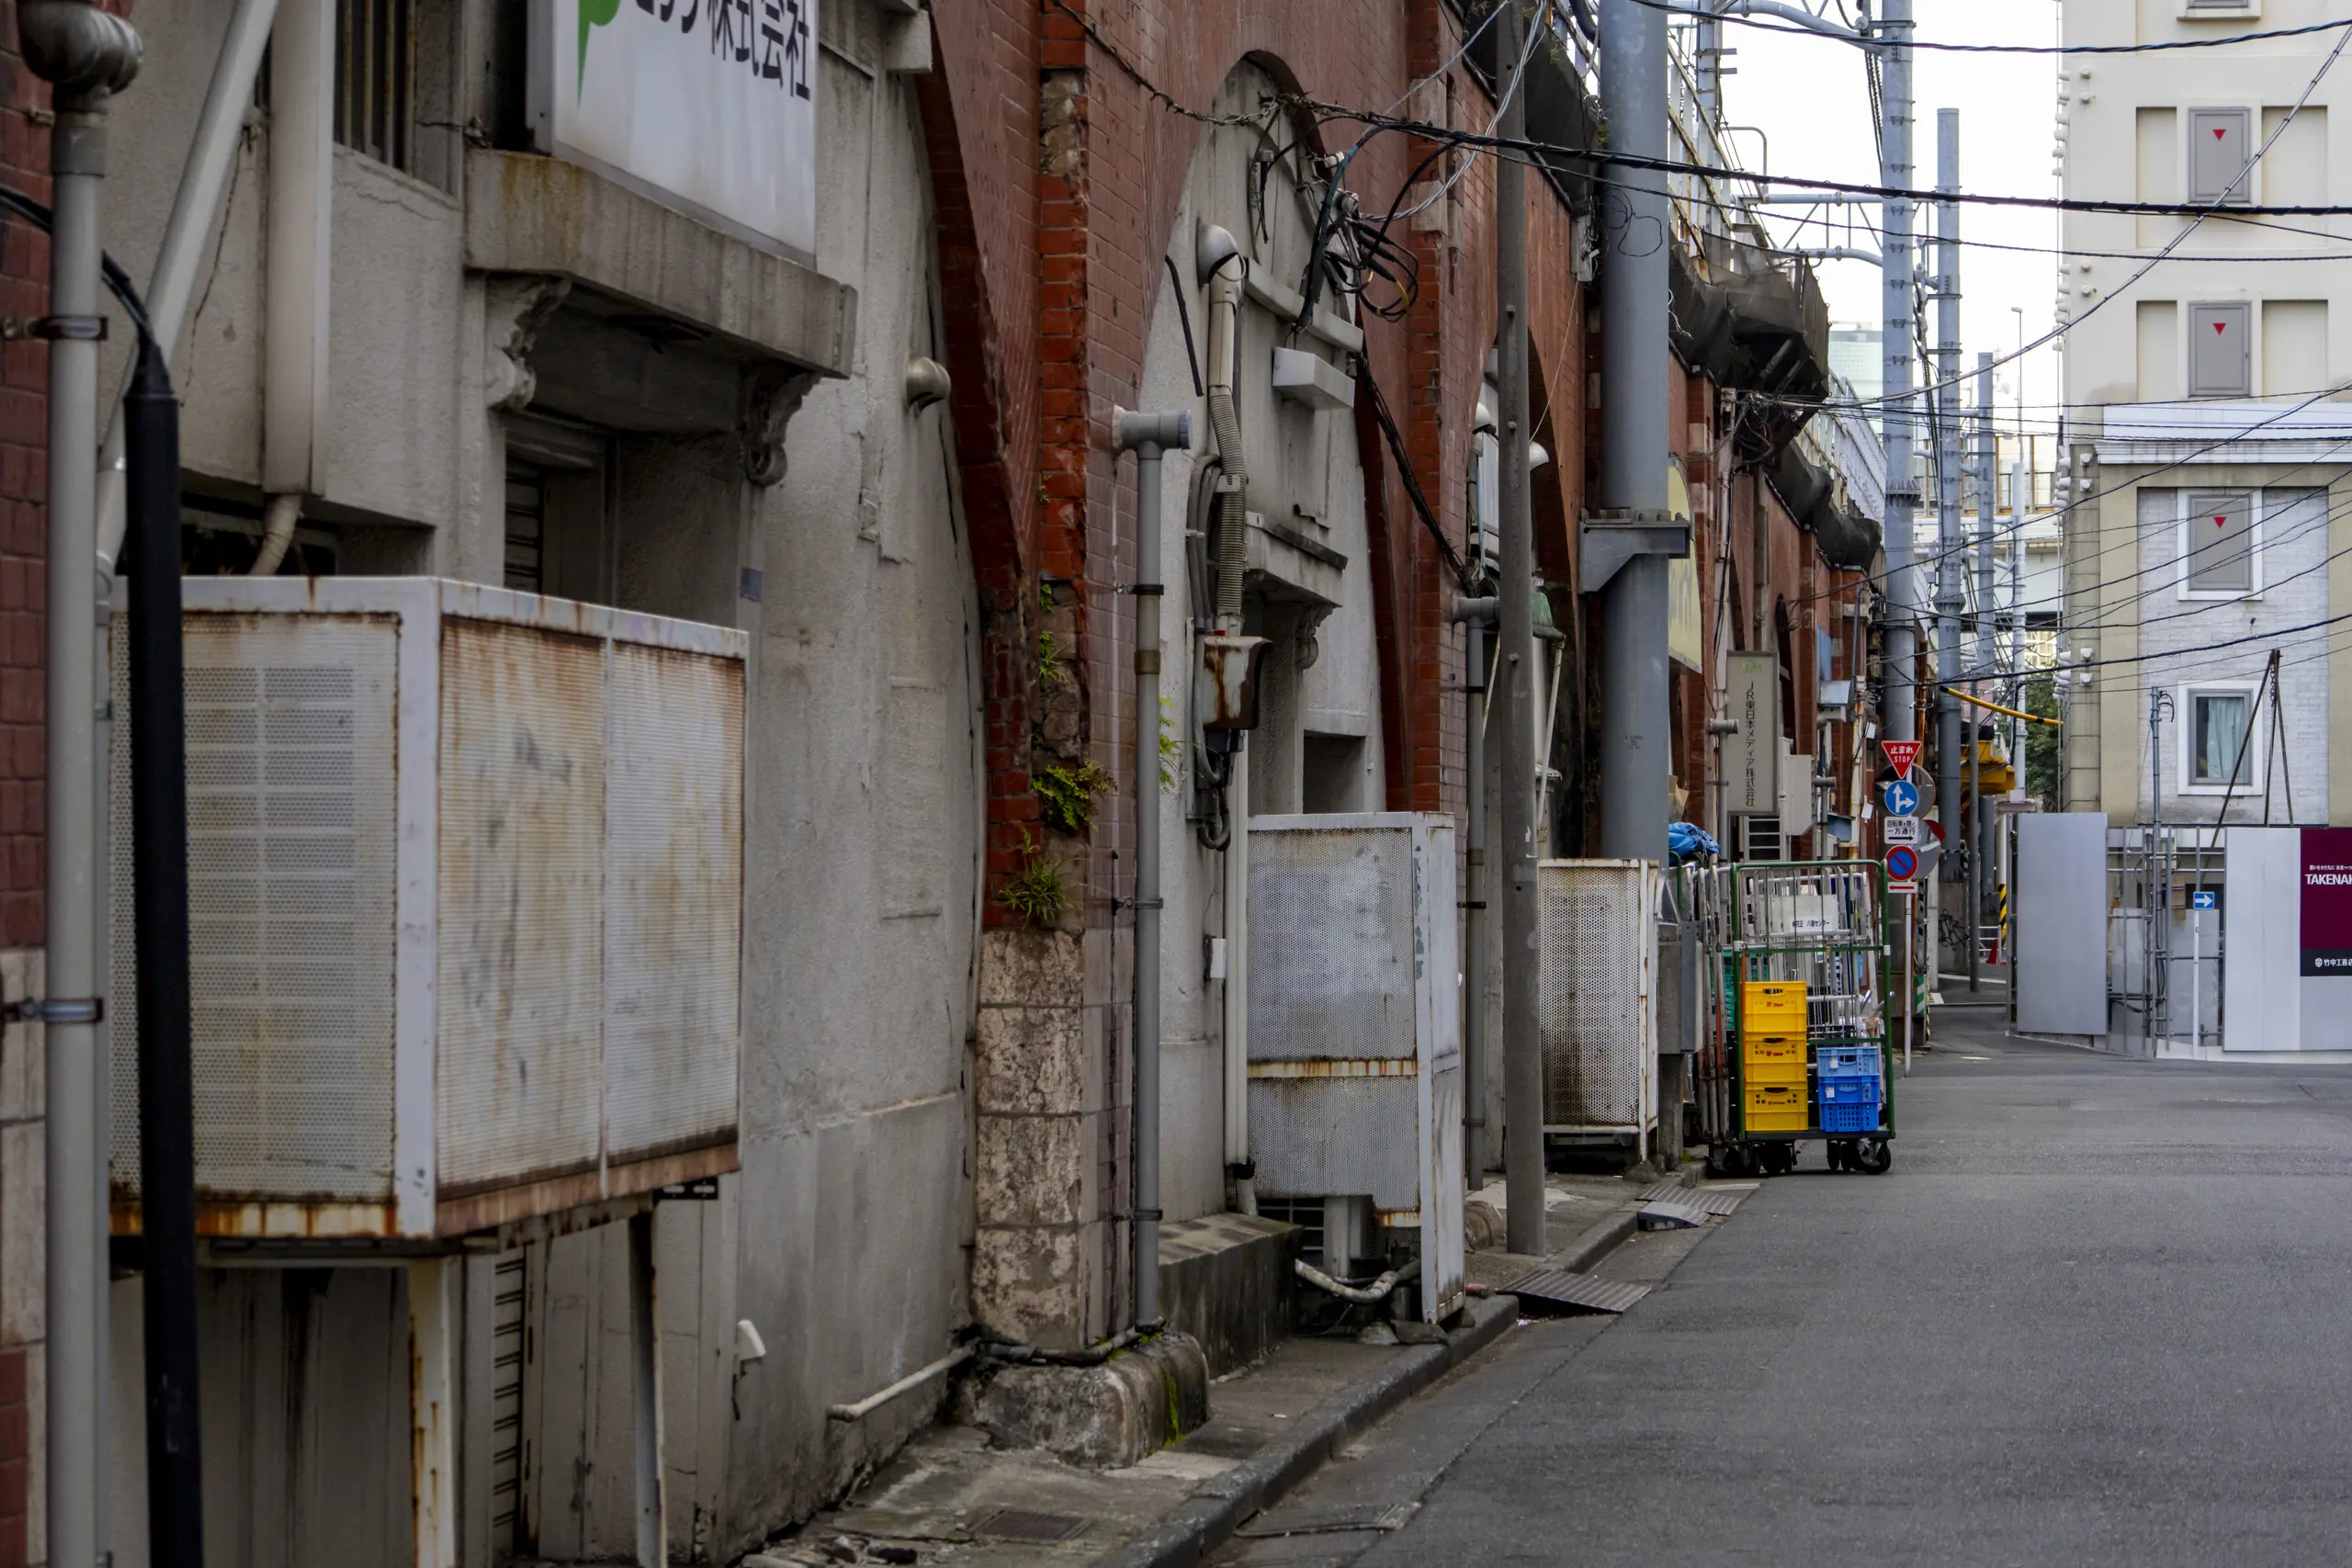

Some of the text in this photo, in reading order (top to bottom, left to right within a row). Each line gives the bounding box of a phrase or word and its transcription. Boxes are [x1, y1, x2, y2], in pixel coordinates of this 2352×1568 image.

[636, 0, 810, 101] 株式会社
[1746, 681, 1756, 807] JR東日本メディア株式会社
[1890, 745, 1914, 754] 止まれ
